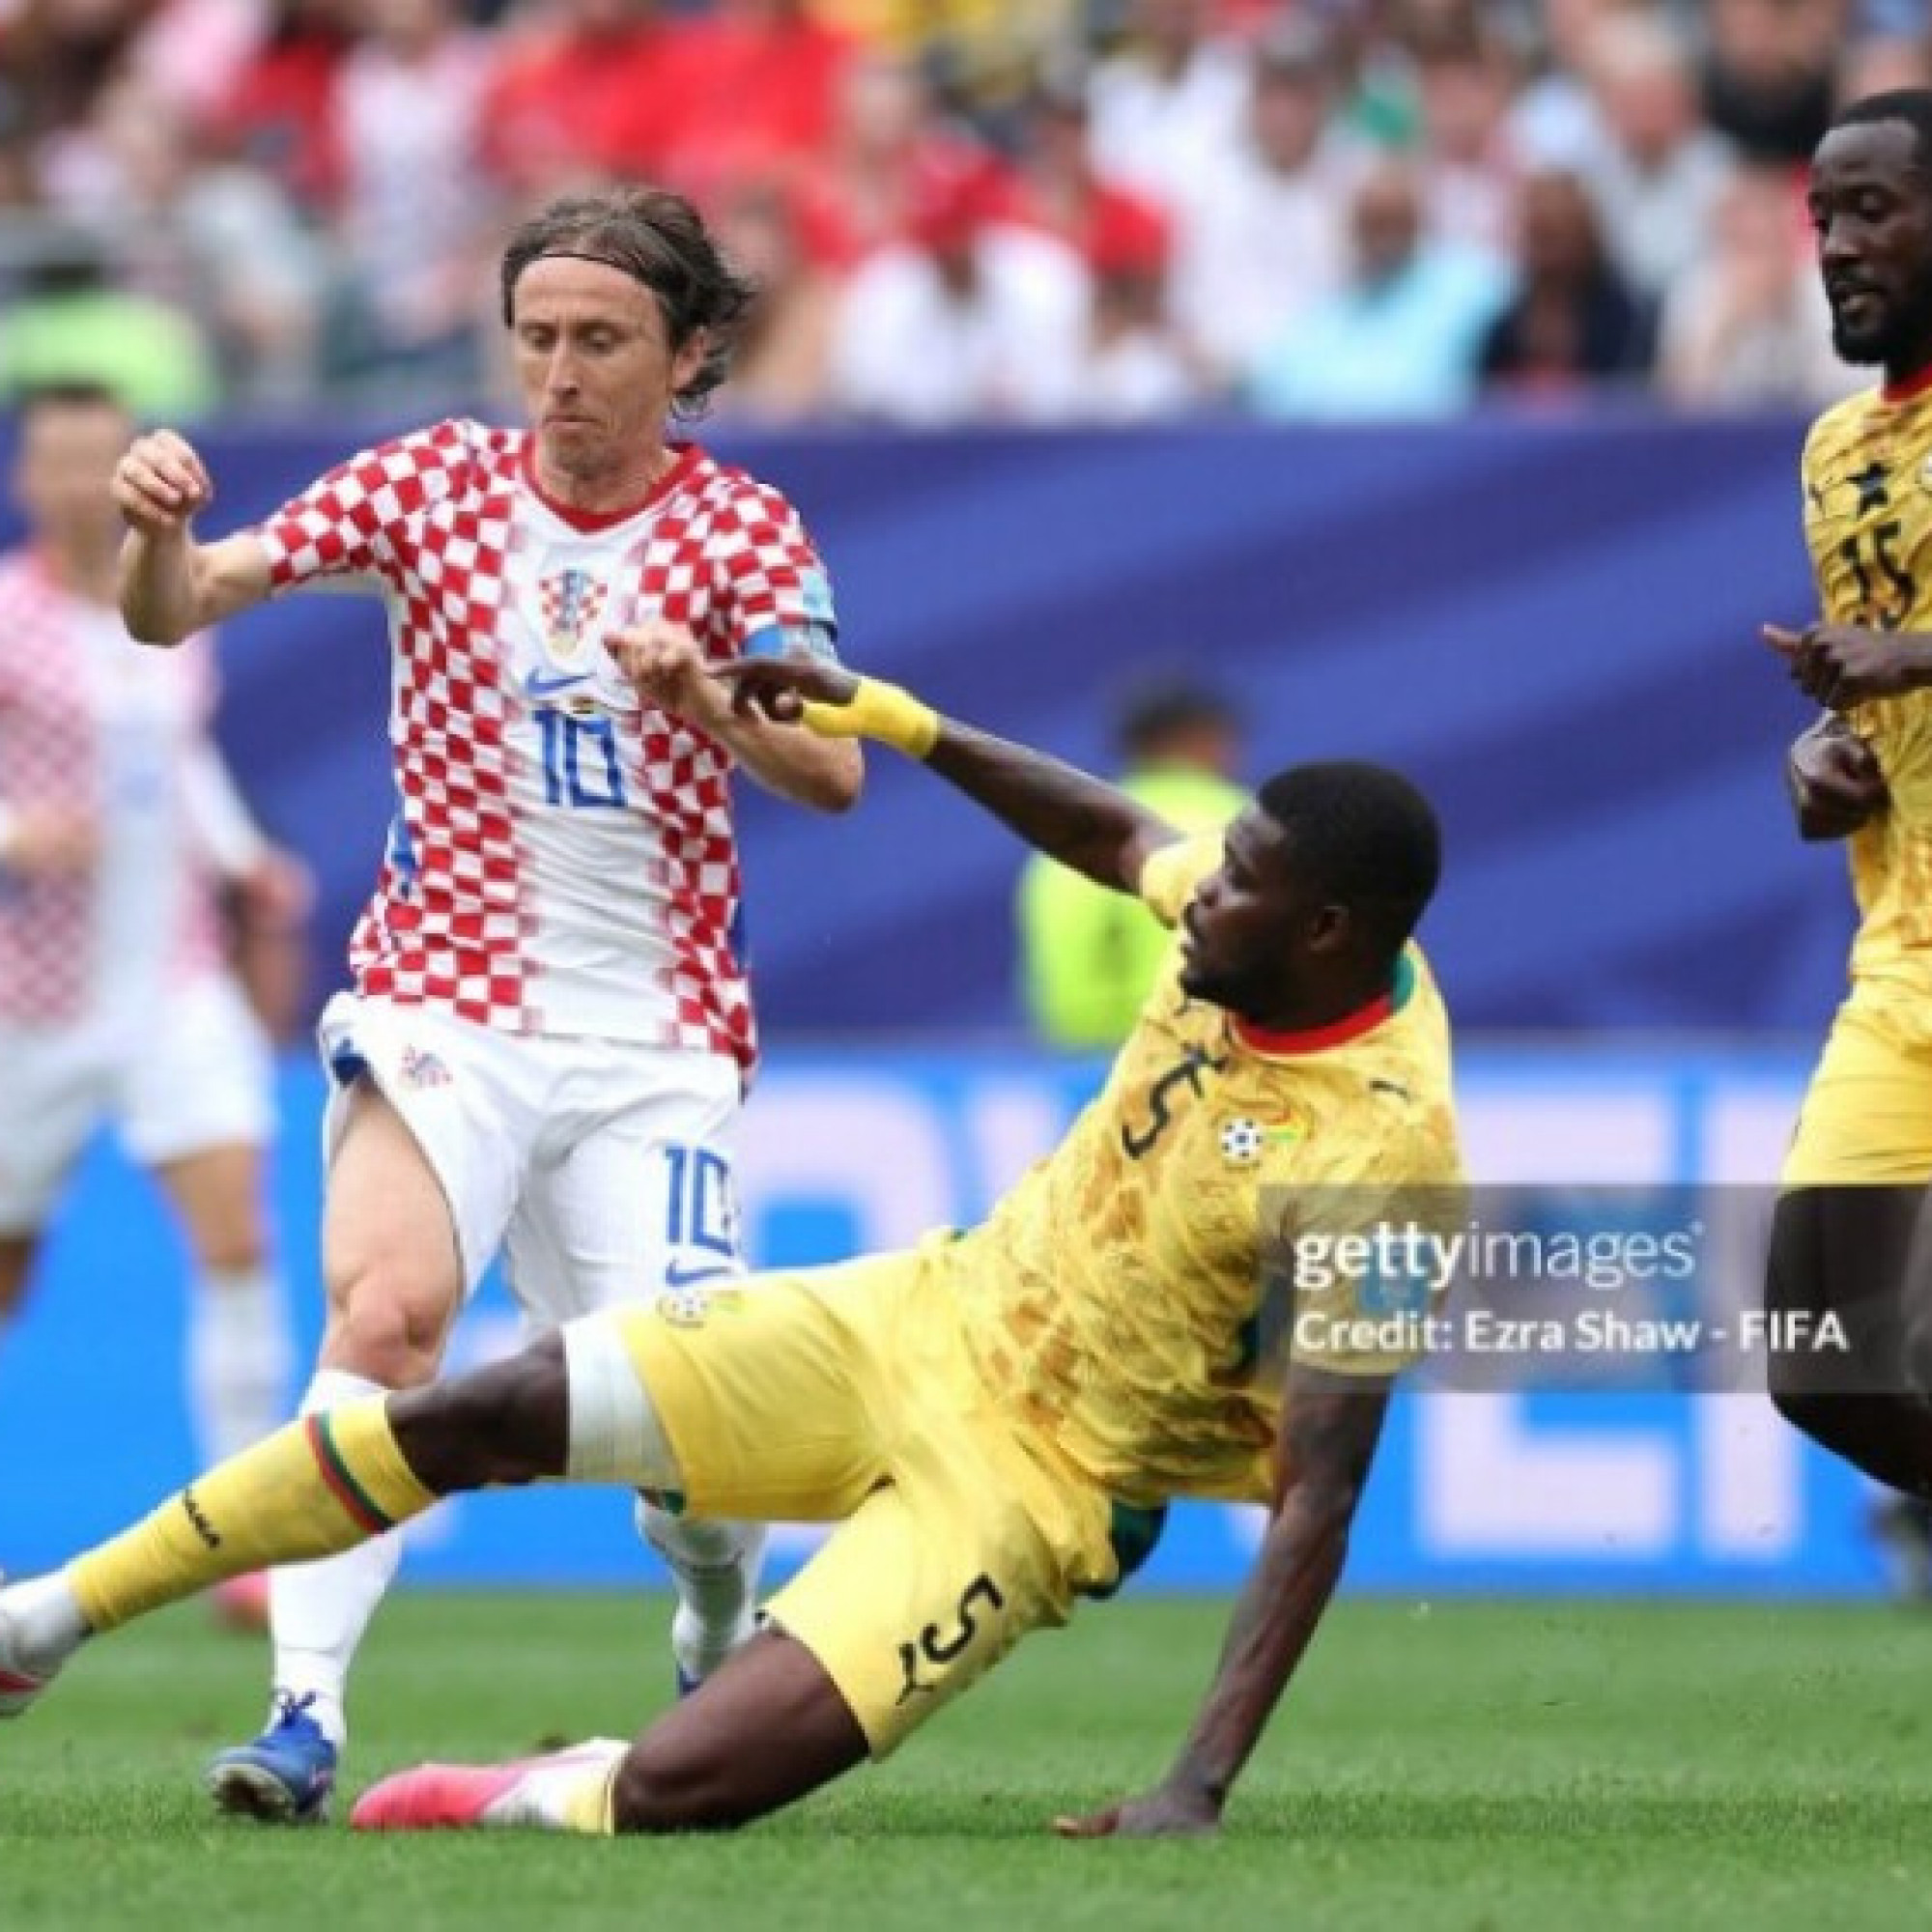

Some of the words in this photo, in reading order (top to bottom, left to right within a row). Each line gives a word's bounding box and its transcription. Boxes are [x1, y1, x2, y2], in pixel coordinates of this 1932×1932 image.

[1841, 520, 1916, 631] 15
[533, 707, 626, 809] 10
[1121, 1061, 1205, 1160] 5
[665, 1146, 734, 1258] 10
[920, 1572, 1005, 1663] 5
